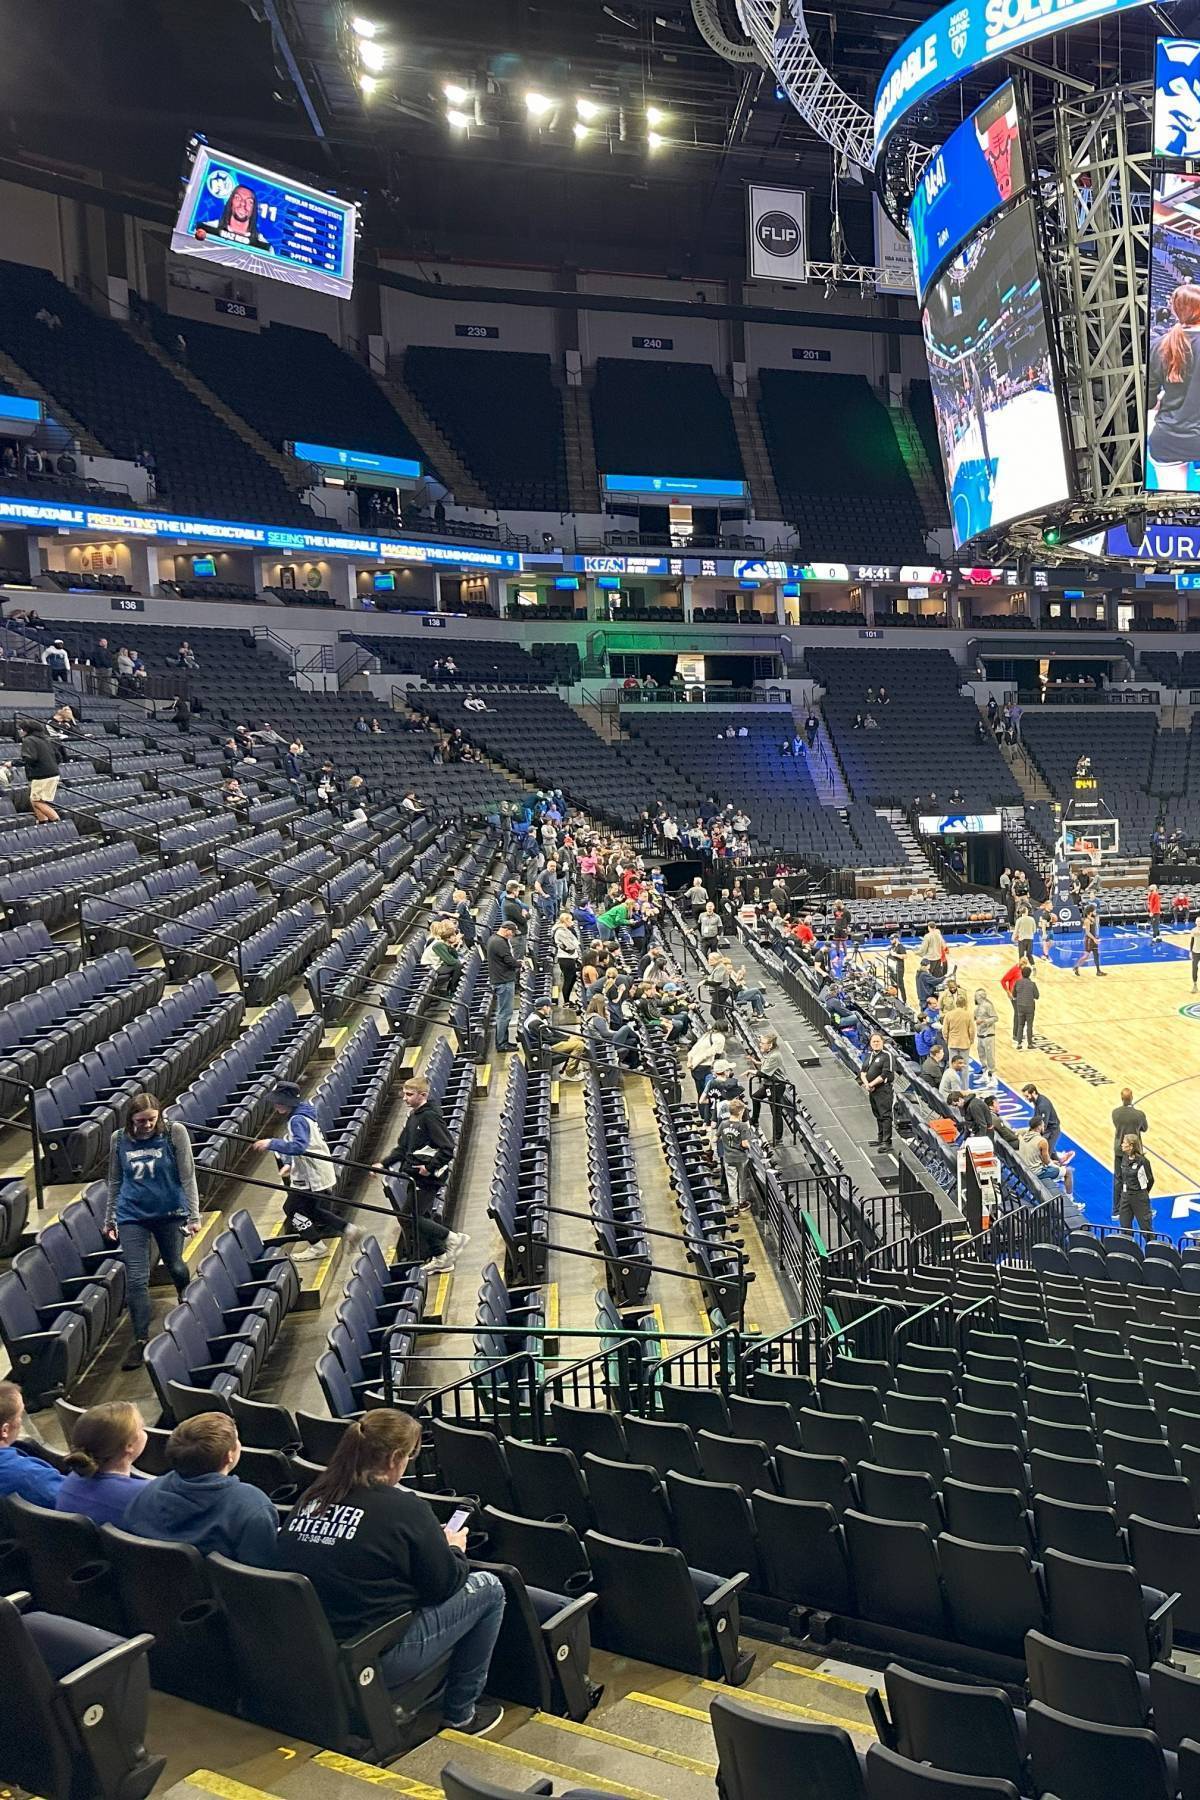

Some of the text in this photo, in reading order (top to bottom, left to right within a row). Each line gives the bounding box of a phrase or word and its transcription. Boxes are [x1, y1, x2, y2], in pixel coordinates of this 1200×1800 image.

[950, 8, 969, 26] MAYO
[948, 19, 970, 38] CLINIC
[260, 203, 278, 222] 11
[760, 226, 798, 242] FLIP
[226, 302, 246, 316] 238
[466, 326, 488, 337] 239
[643, 338, 662, 349] 240
[803, 350, 819, 360] 201
[87, 512, 157, 531] PREDICTING
[156, 520, 182, 534] THE
[267, 531, 304, 546] SEEING
[585, 556, 626, 573] KFAN
[829, 567, 836, 578] 0
[858, 566, 891, 580] 84:41
[912, 570, 919, 581] 0
[119, 600, 137, 610] 136
[130, 1158, 156, 1180] 21
[288, 1518, 358, 1541] CATERING
[363, 1670, 371, 1682] H
[90, 1708, 97, 1721] J
